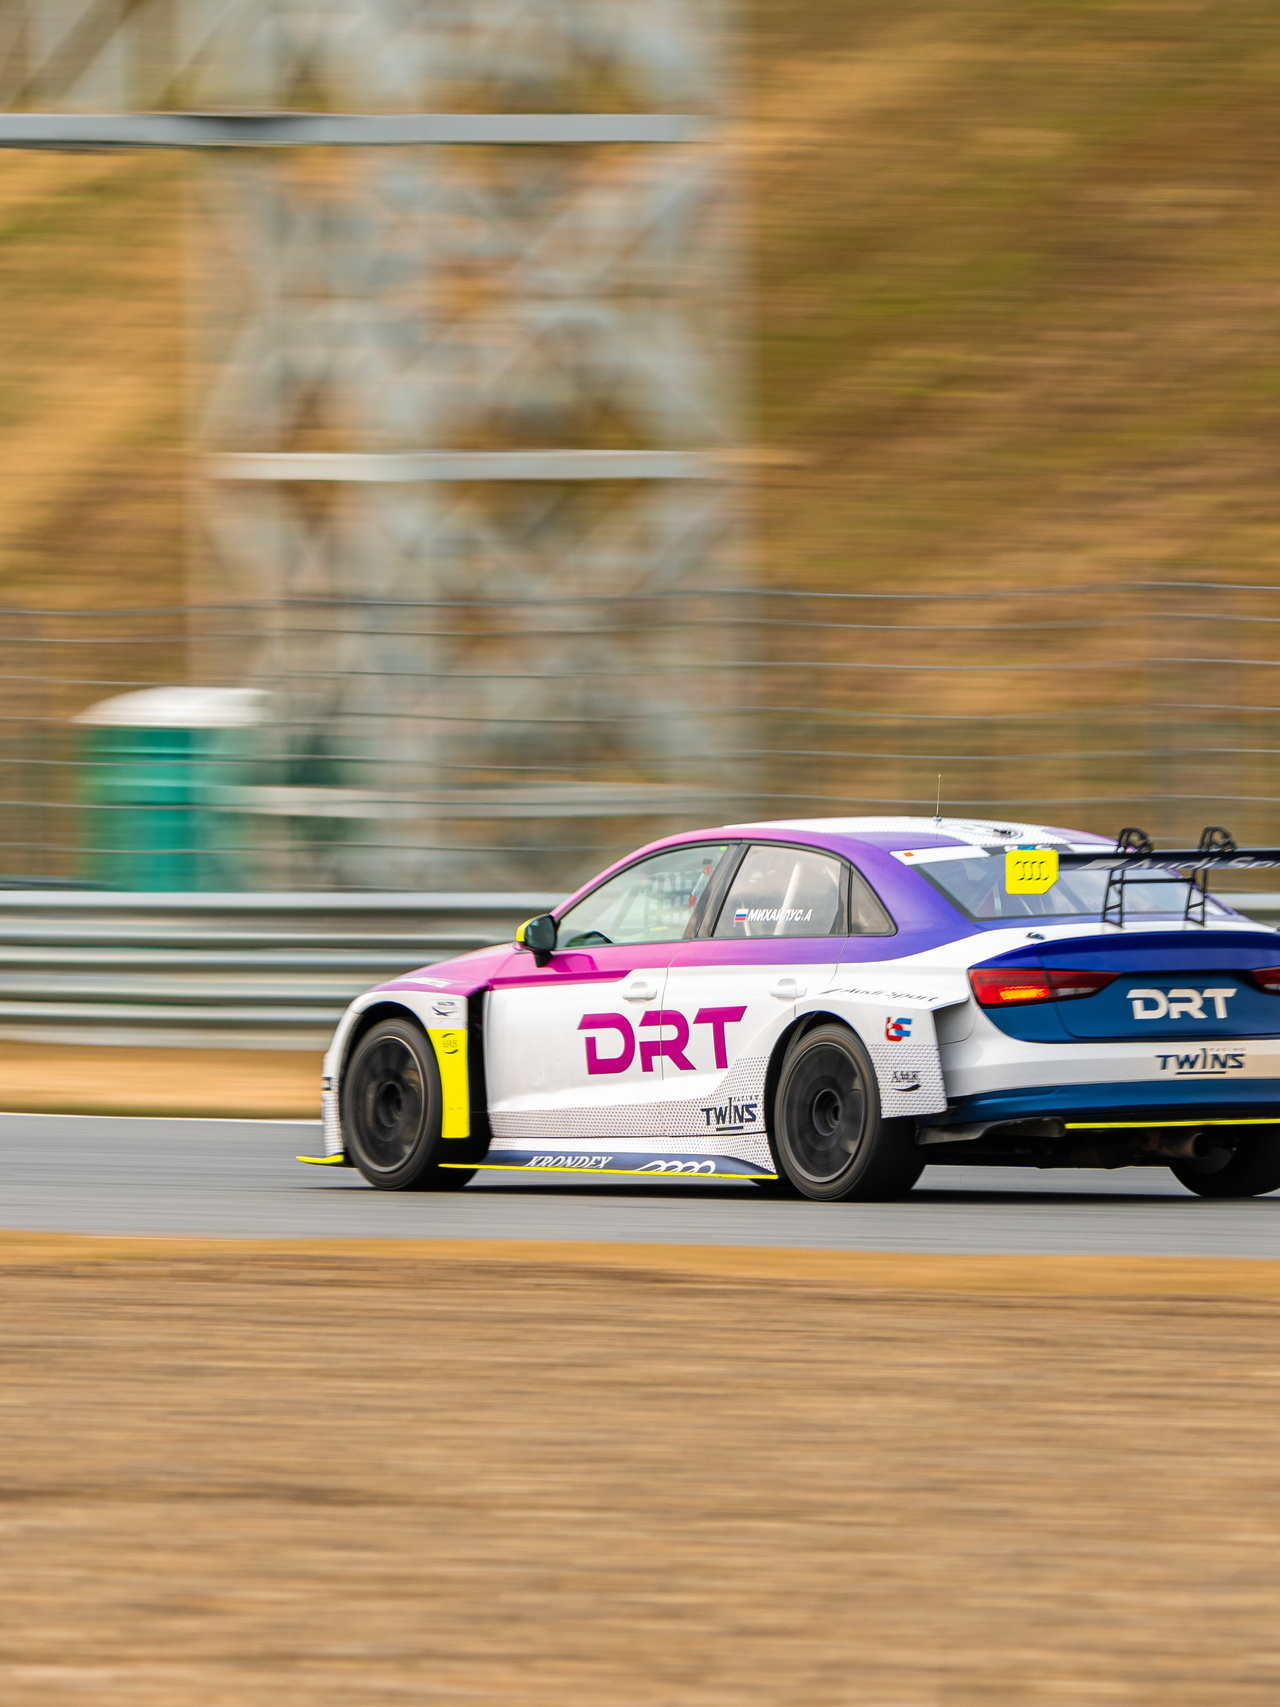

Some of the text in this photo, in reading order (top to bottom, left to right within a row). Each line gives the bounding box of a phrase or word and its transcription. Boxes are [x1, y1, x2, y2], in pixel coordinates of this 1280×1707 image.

[1127, 856, 1221, 870] Audi
[1126, 988, 1238, 1019] DRT
[577, 1006, 748, 1075] DRT
[1154, 1048, 1245, 1070] TWINS
[700, 1097, 758, 1126] TWINS
[523, 1155, 614, 1169] KRONDEX
